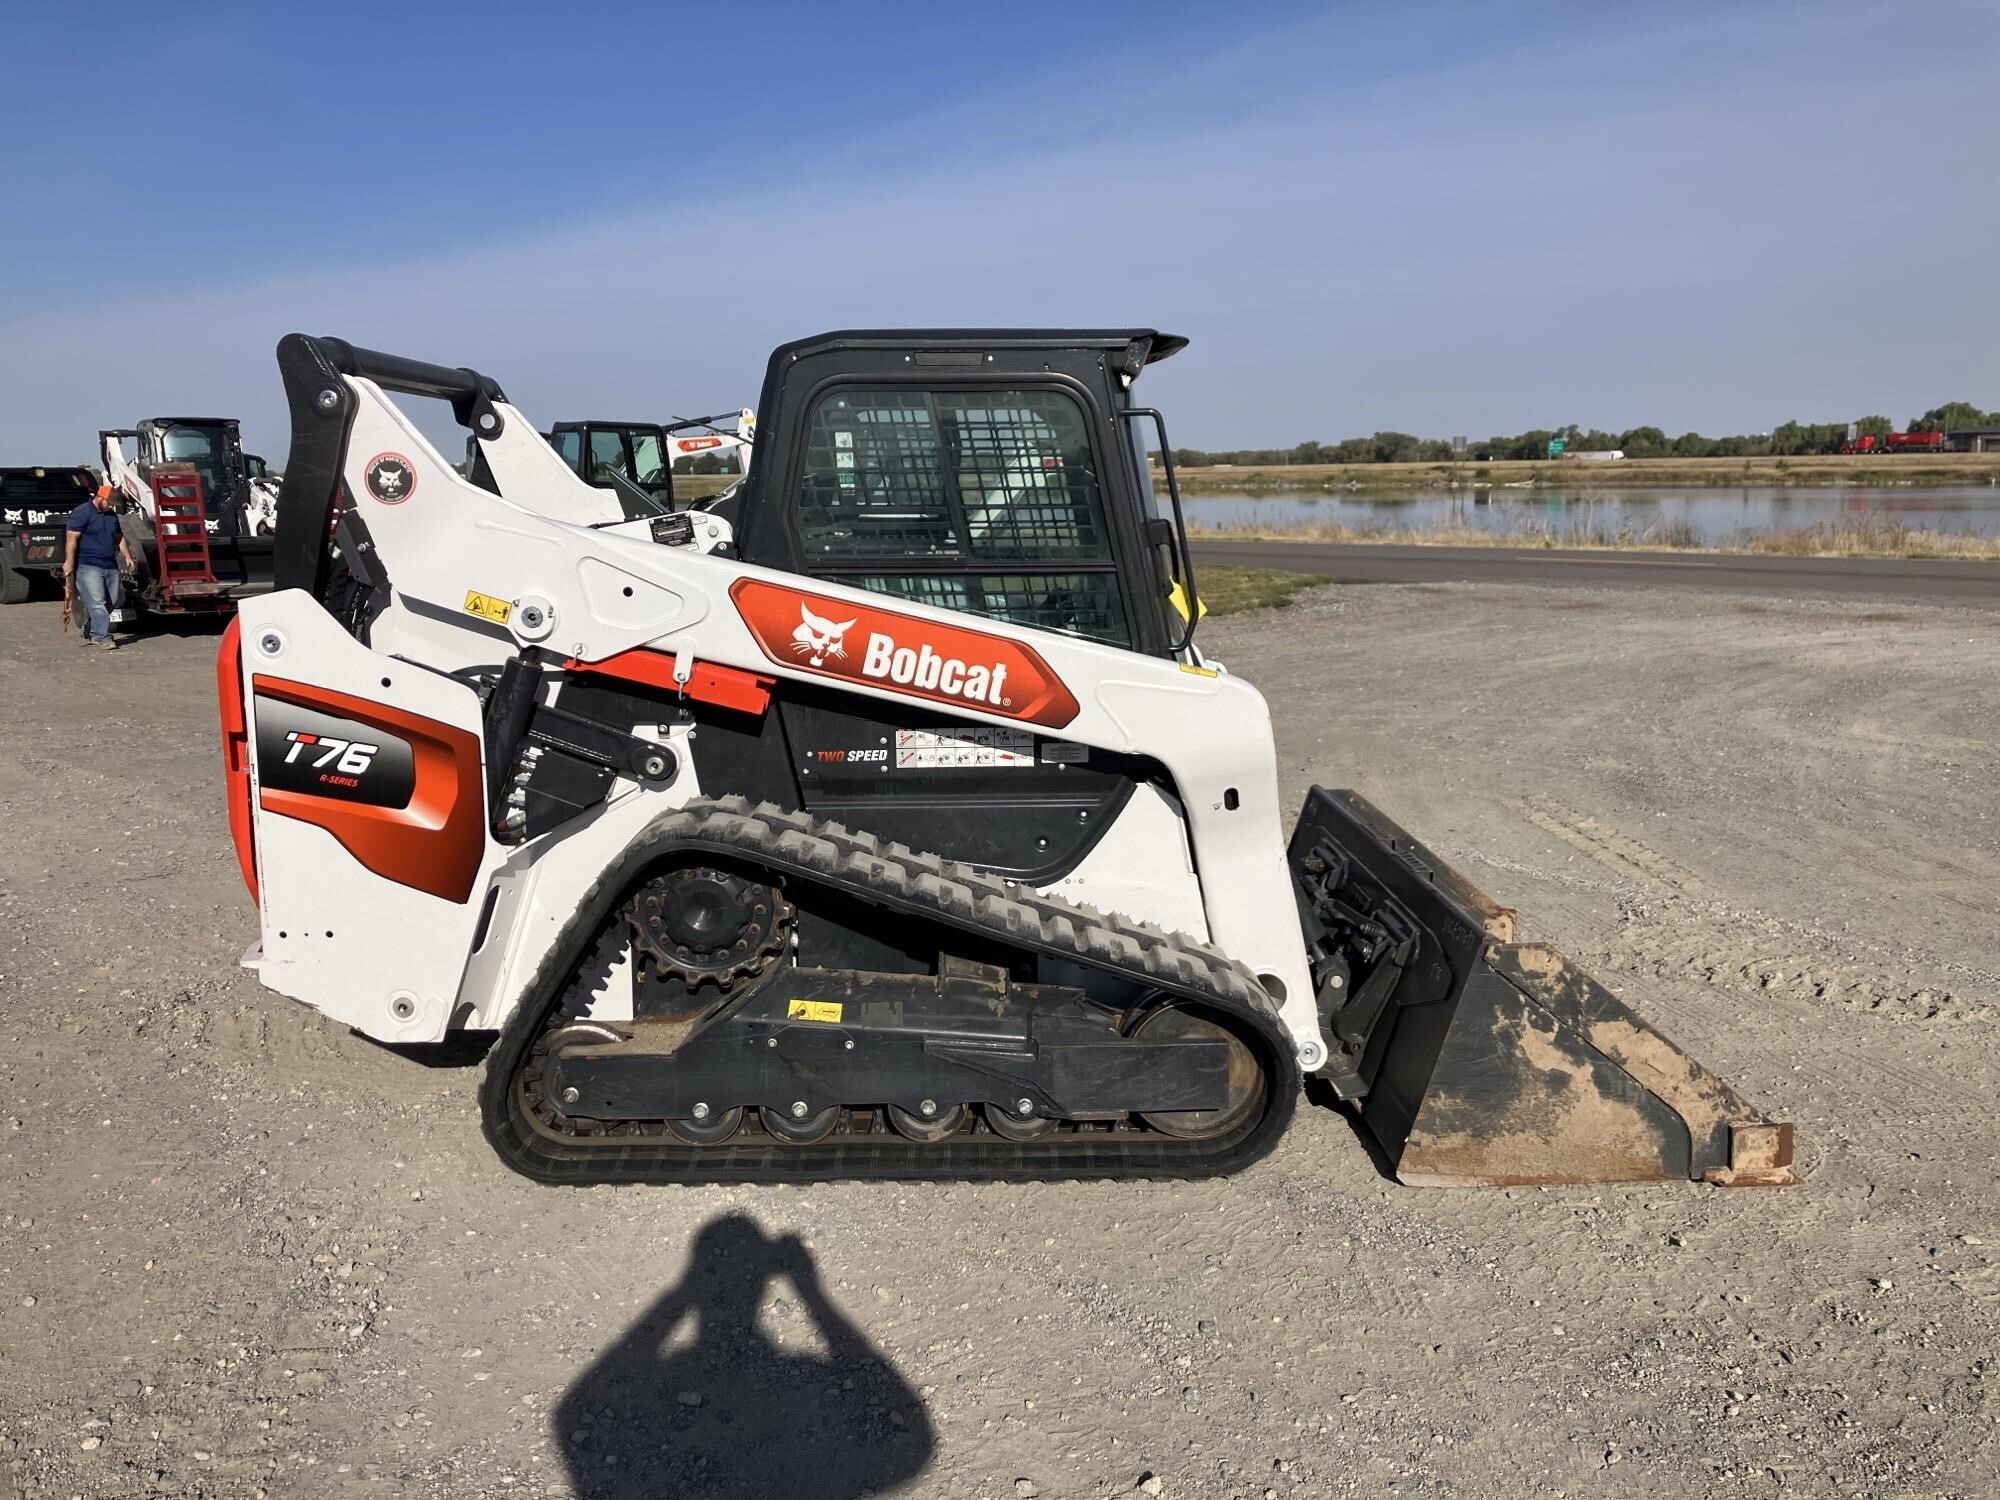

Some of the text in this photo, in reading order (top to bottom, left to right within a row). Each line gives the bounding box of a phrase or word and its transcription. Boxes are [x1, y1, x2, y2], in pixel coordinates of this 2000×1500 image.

[862, 632, 1008, 705] Bobcat
[284, 731, 379, 775] T76
[816, 749, 888, 762] TWO SPEED
[320, 774, 359, 788] R-SERIES
